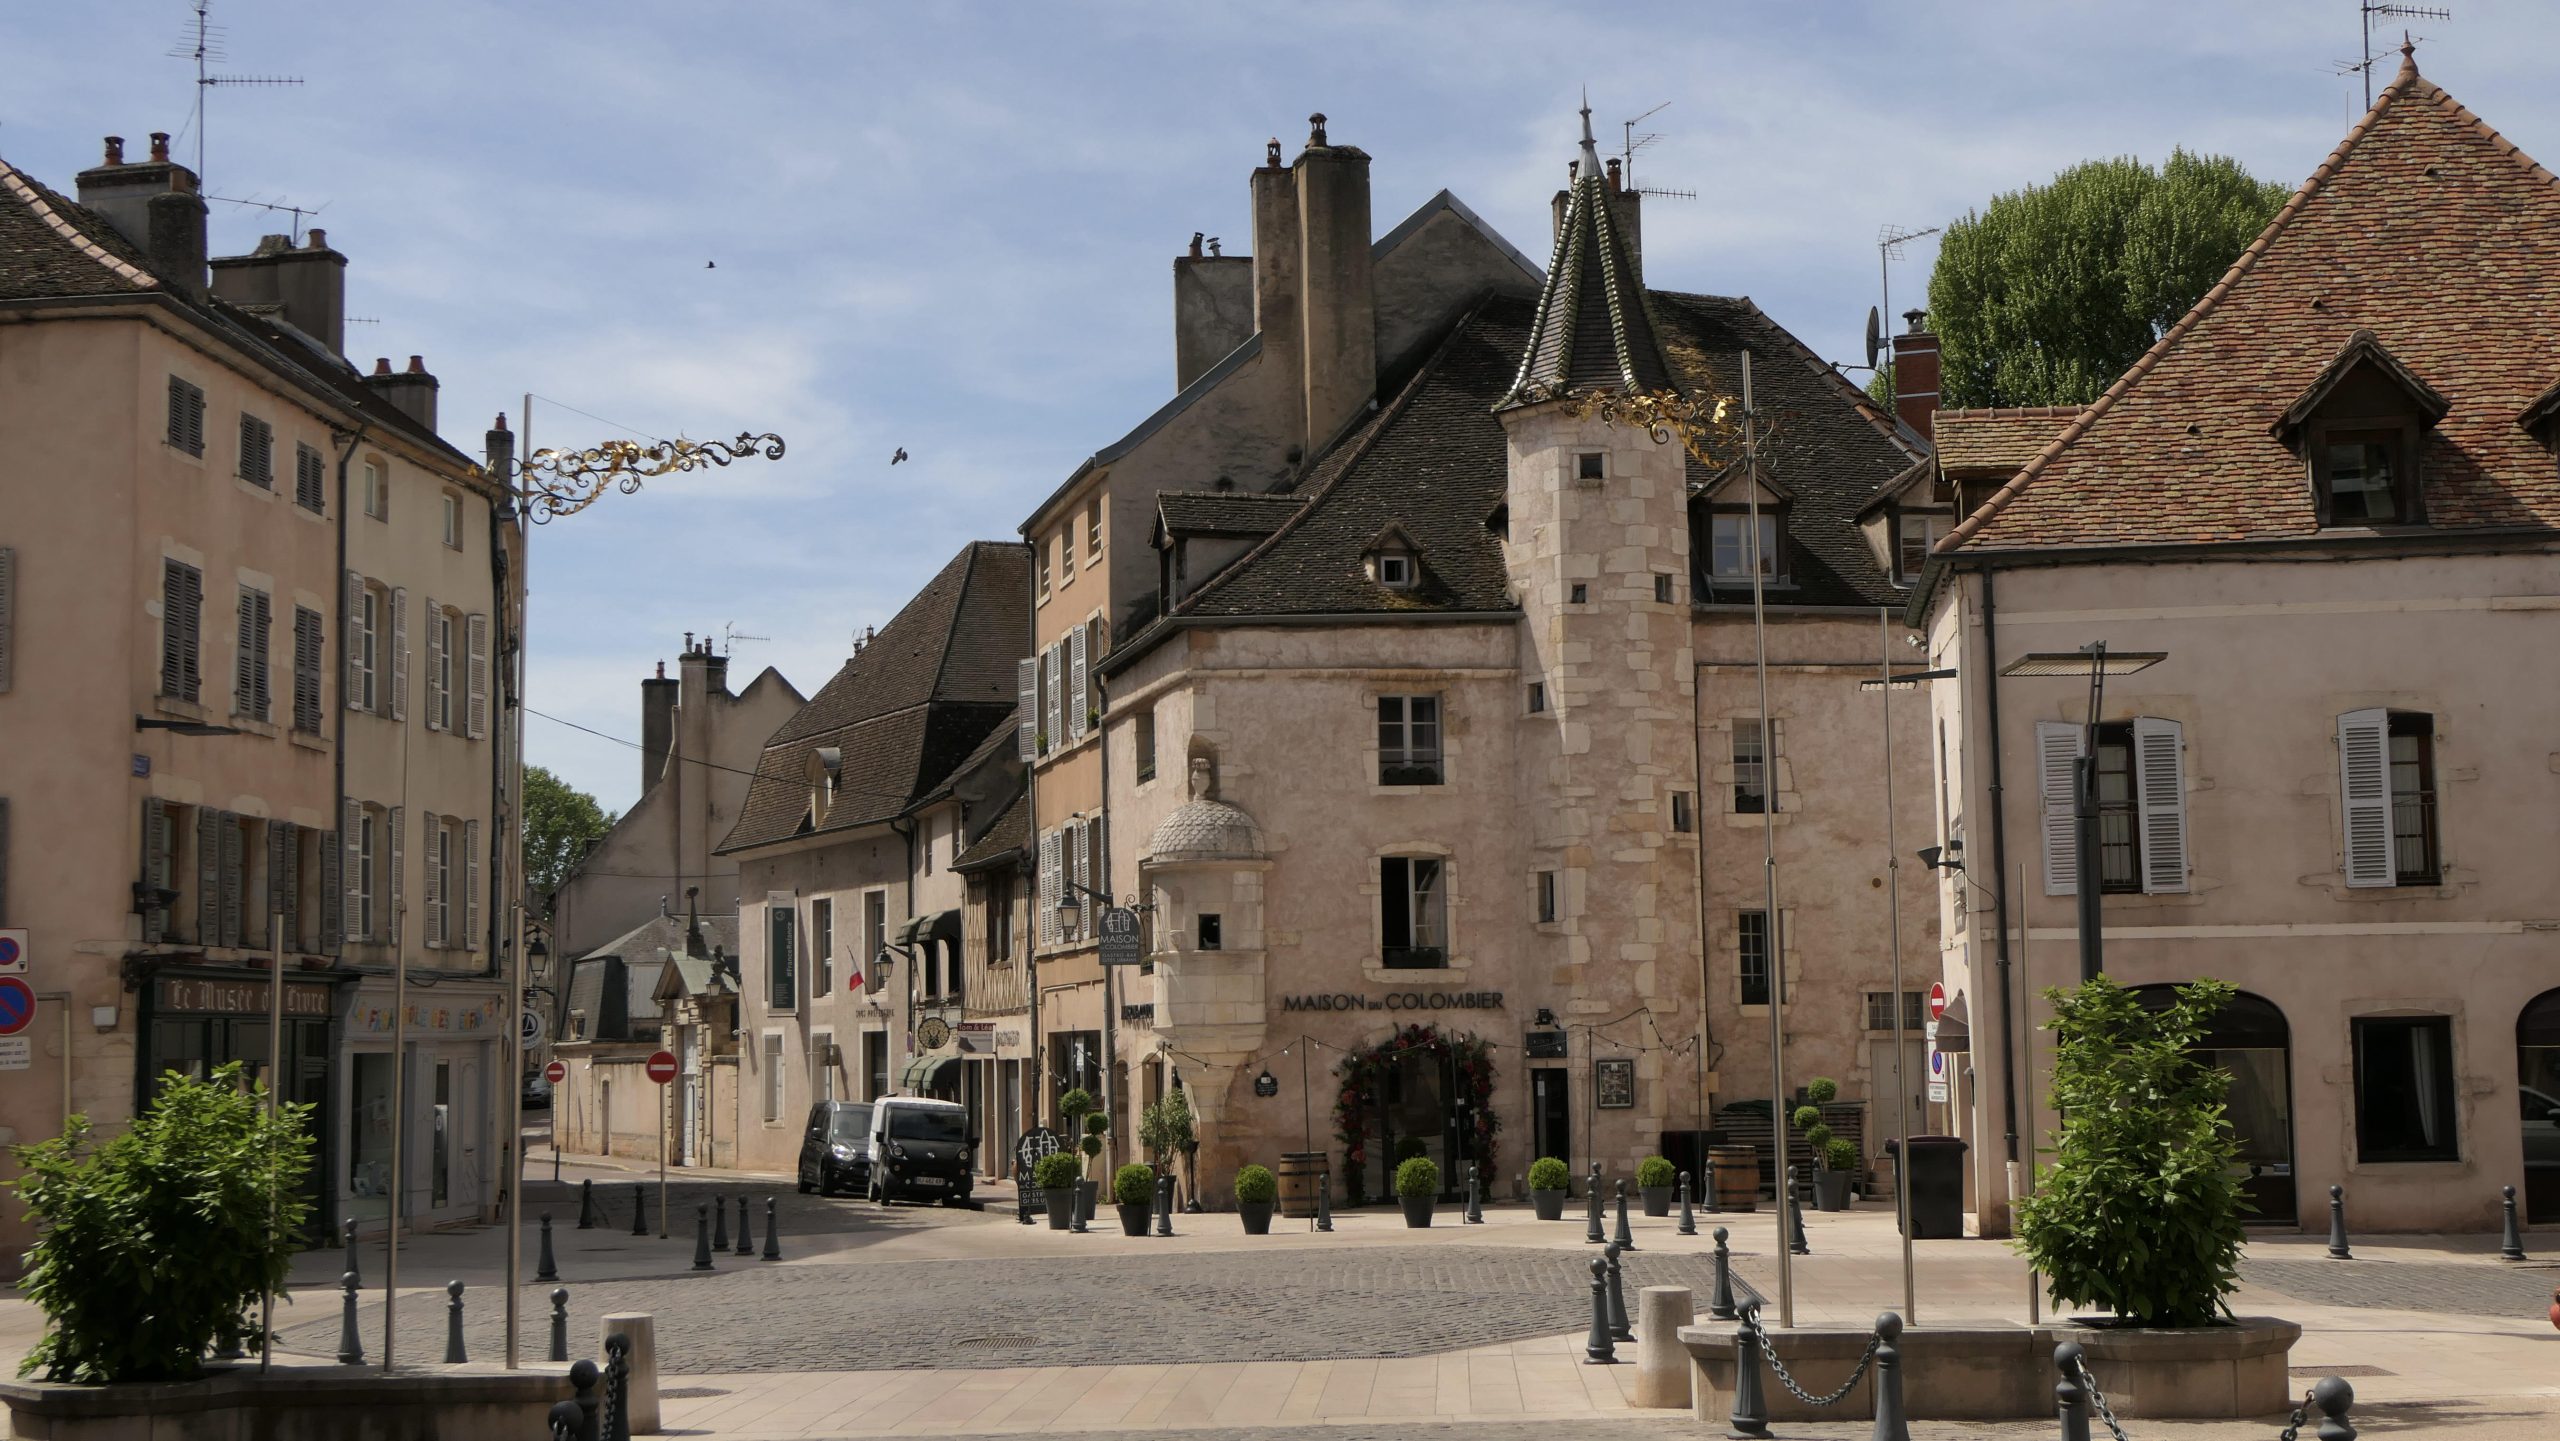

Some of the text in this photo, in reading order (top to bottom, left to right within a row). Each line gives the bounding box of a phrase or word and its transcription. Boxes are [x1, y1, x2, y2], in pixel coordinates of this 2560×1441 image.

[1101, 935, 1139, 944] MAISON
[172, 980, 191, 1009] Le
[198, 981, 253, 1012] Musée
[287, 985, 325, 1013] Livre
[1284, 994, 1365, 1012] MAISON
[1385, 993, 1504, 1011] COLOMBIER
